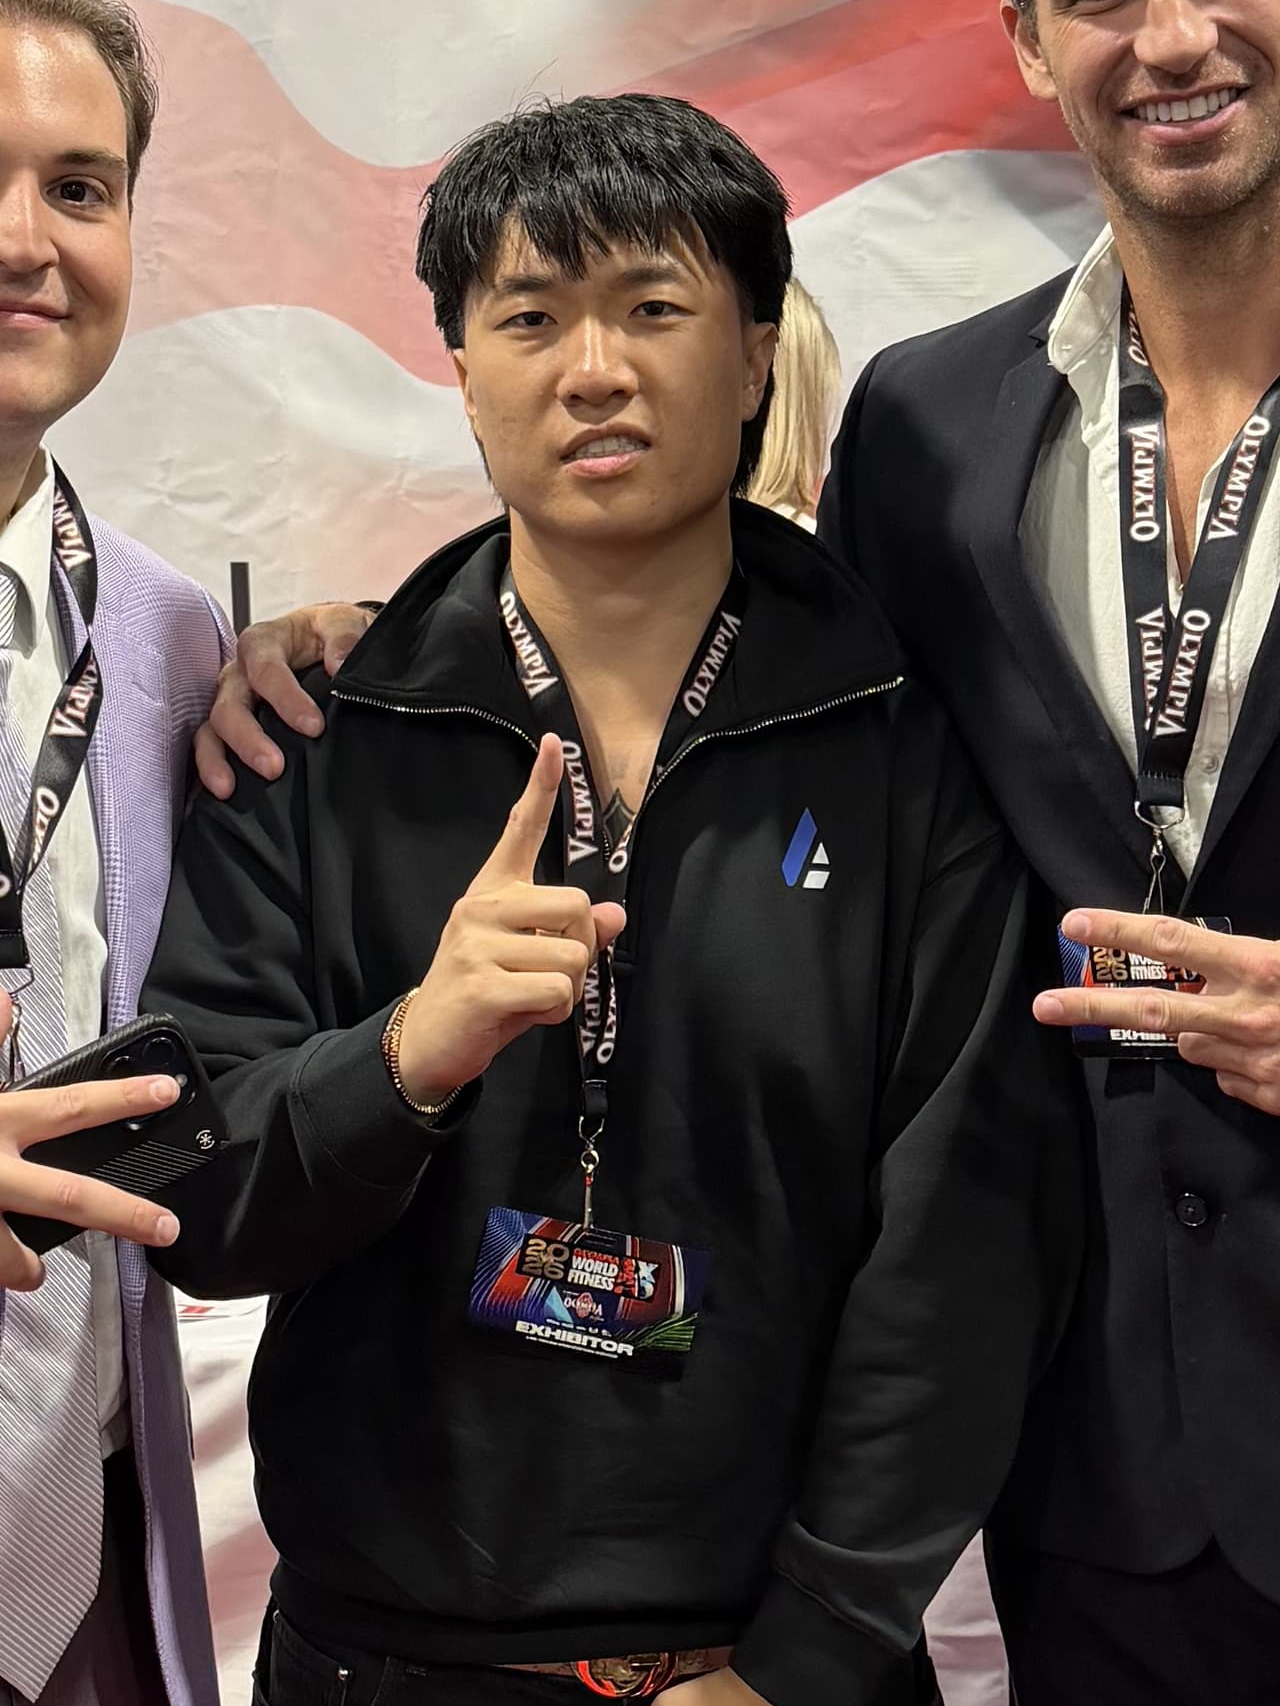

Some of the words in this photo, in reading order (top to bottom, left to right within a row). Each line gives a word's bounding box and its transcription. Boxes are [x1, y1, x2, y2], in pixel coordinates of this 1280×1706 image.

[1127, 421, 1161, 543] OLYMPIA
[1204, 413, 1272, 544] OLYMPIA
[500, 591, 559, 701] OLYMPIA
[682, 610, 742, 719] OLYMPIA
[1152, 608, 1212, 740] OLYMPIA
[561, 740, 600, 867] OLYMPIA
[566, 1269, 616, 1292] FITNESS
[571, 1254, 619, 1279] WORLD
[514, 1320, 636, 1357] EXHIBITOR
